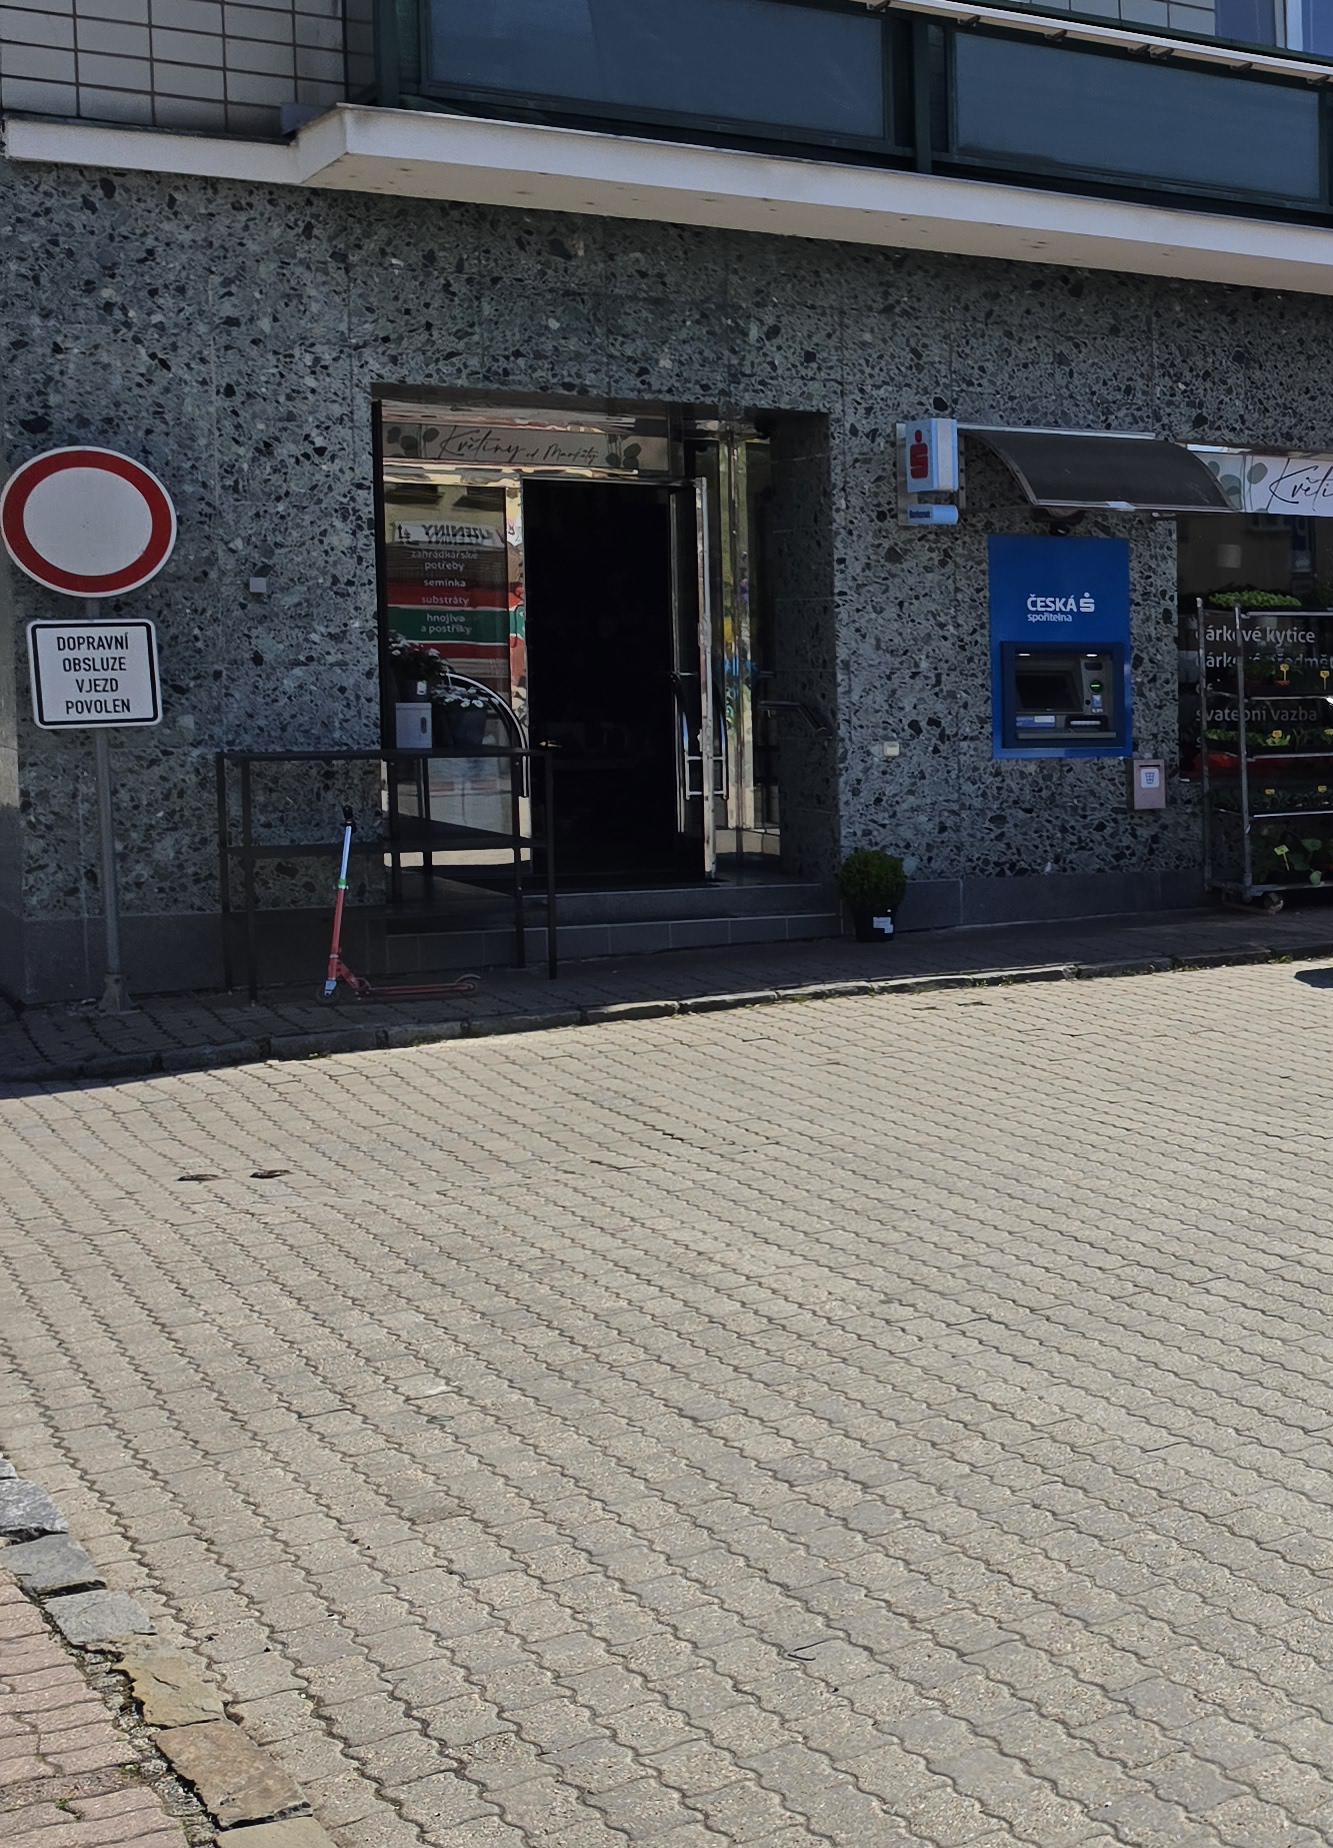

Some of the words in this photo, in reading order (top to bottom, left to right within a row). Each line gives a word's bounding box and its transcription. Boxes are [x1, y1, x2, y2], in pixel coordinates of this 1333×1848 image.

[424, 560, 465, 572] potřeby
[1027, 593, 1077, 611] ČESKÁ
[426, 613, 466, 625] hnojiva
[1027, 611, 1073, 623] spořitelna
[56, 631, 129, 651] DOPRAVNÍ
[1266, 626, 1316, 646] kytice
[62, 656, 127, 673] OBSLUZE
[75, 677, 119, 694] VJEZD
[65, 698, 130, 714] POVOLEN
[1271, 706, 1318, 722] vazba
